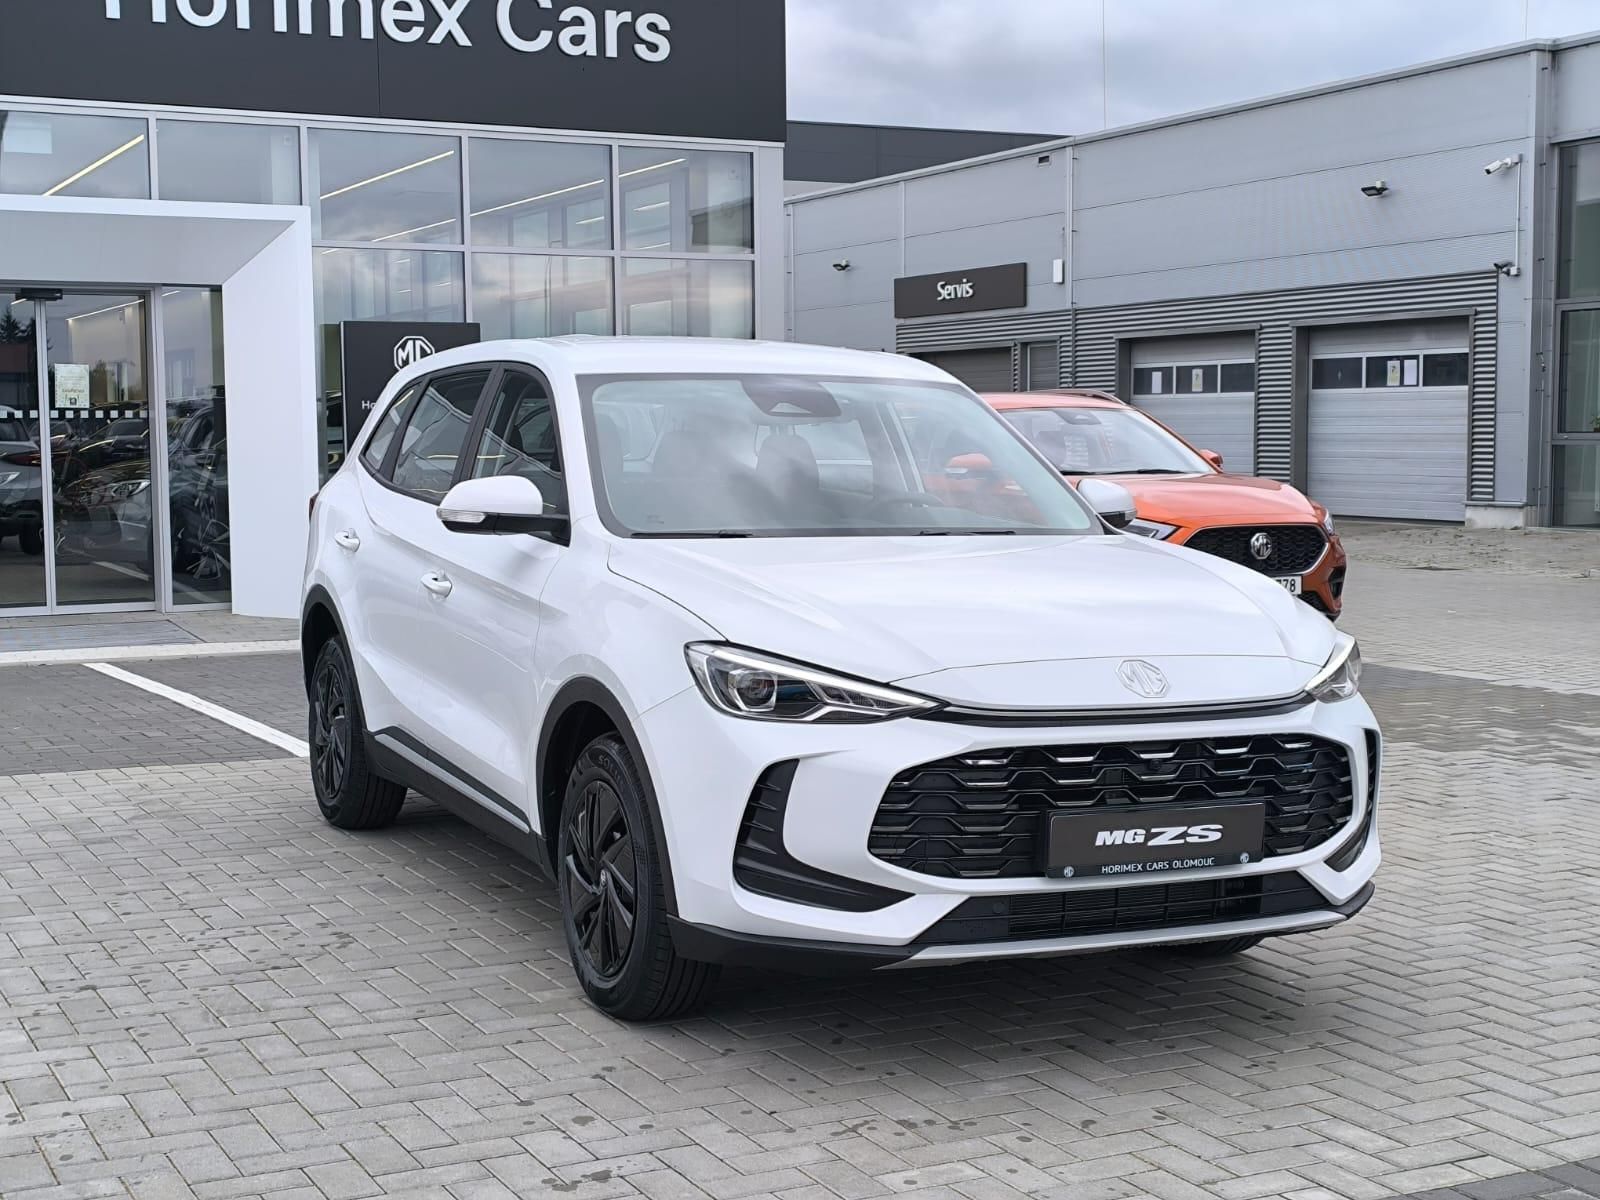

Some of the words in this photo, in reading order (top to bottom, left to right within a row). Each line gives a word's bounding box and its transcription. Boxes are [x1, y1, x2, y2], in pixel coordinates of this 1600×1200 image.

[497, 0, 671, 62] Cars
[937, 278, 973, 300] Servis
[1117, 660, 1168, 697] MG
[1101, 863, 1143, 874] HORIMEX
[1146, 861, 1169, 871] CARS
[1172, 857, 1215, 869] OLOMOUC
